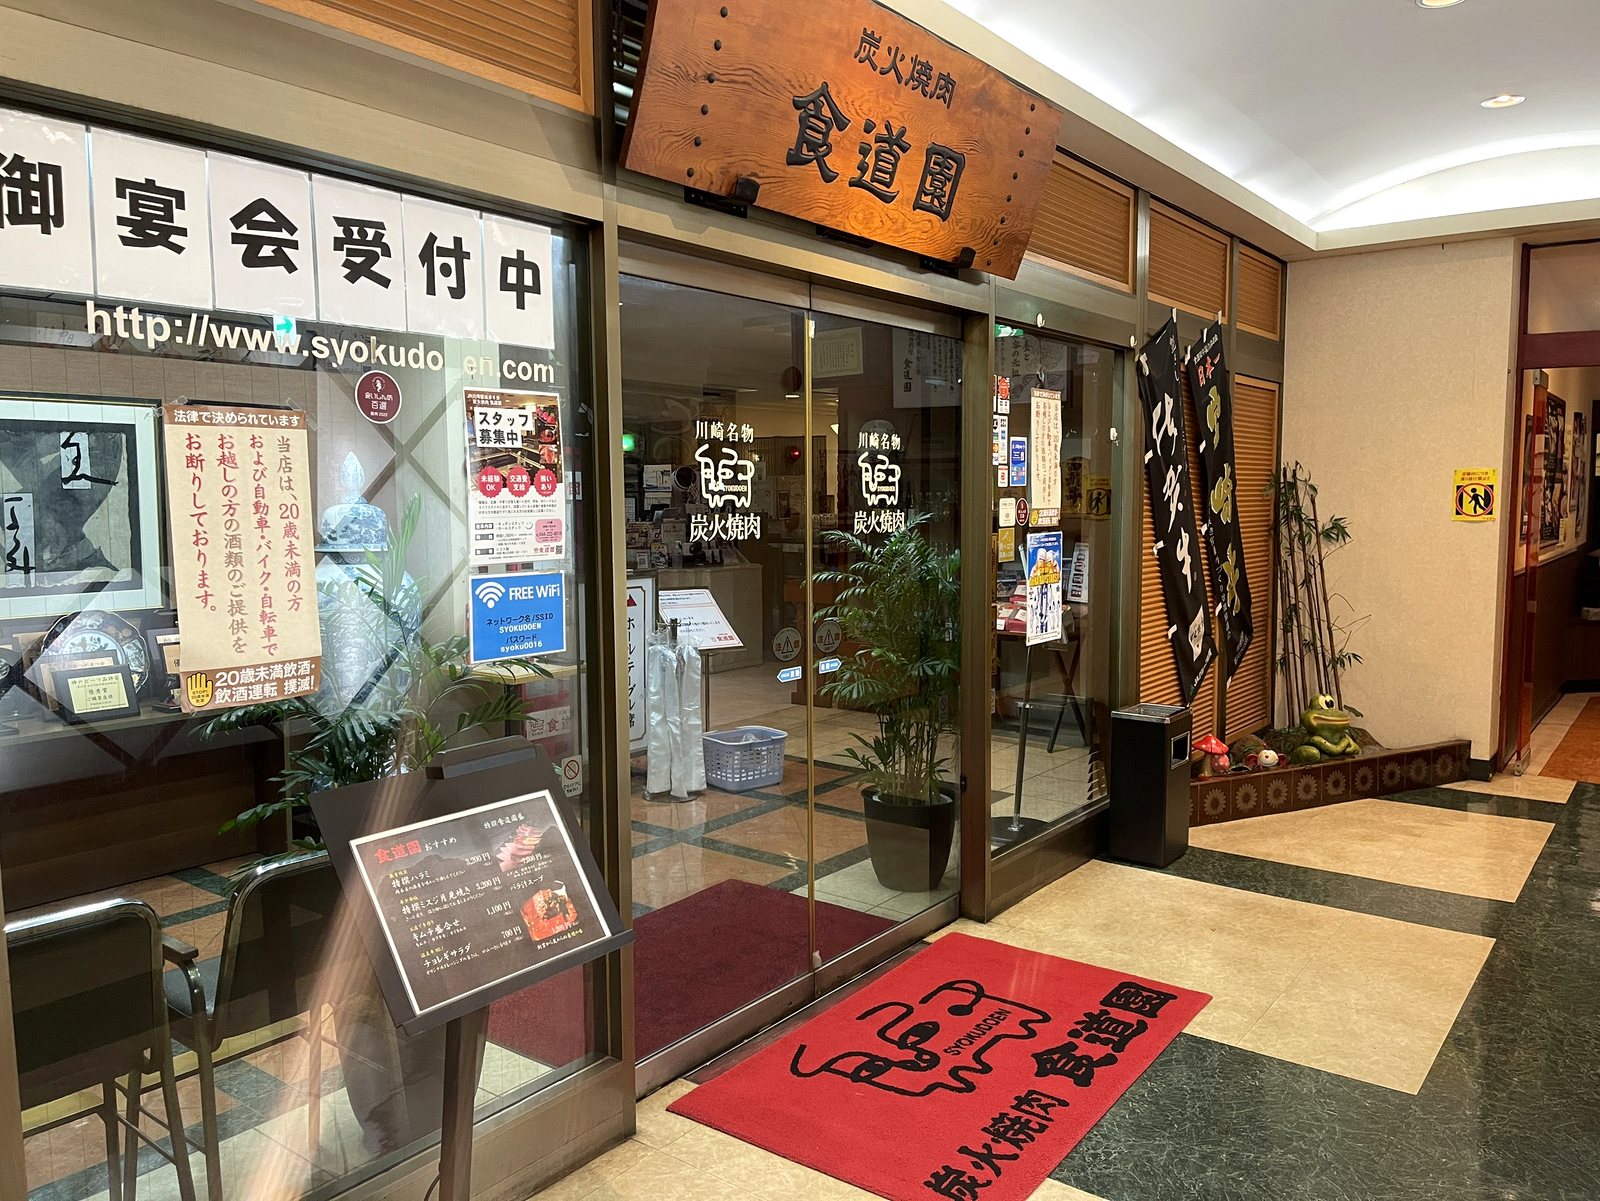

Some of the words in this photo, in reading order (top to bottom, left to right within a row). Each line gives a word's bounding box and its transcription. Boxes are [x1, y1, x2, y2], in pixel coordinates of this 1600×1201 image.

[785, 81, 966, 223] 食道園
[0, 153, 543, 311] 御宴会受付中
[174, 409, 300, 427] 法律で決められています
[479, 411, 528, 427] スタッフ
[479, 428, 518, 446] 募集中
[695, 420, 754, 444] 川崎名物
[858, 432, 901, 450] 川崎名物
[480, 474, 500, 483] 未経験
[485, 483, 496, 491] OK
[509, 474, 528, 483] 交通費
[513, 483, 526, 491] 支給
[540, 483, 552, 491] あり
[185, 432, 216, 612] お断りしております。
[277, 435, 304, 612] 当店は、20歳未満の方
[689, 512, 762, 542] 炭火焼肉
[853, 510, 905, 535] 炭火焼肉
[216, 433, 249, 654] お越しの方の酒類のご提供を
[249, 434, 279, 656] および自動車・バイク・自転車で
[509, 586, 534, 600] FREE
[535, 584, 560, 598] WiFi
[499, 622, 542, 634] SYOKUDOEN
[506, 633, 538, 644] パスワード
[500, 640, 543, 652] syoku0016
[214, 682, 278, 704] 飲酒運転
[374, 839, 423, 865] 食道園
[424, 836, 457, 852] おすすめ
[510, 875, 544, 890] バラ汁スープ
[401, 886, 471, 915] 特撰ミスジ月見焼き
[412, 918, 461, 942] キムチ盛合せ
[423, 942, 472, 968] チョレギサラダ
[500, 925, 522, 939] 700円
[943, 1007, 1013, 1057] SYOKUDOEN
[1030, 981, 1179, 1087] 食道園
